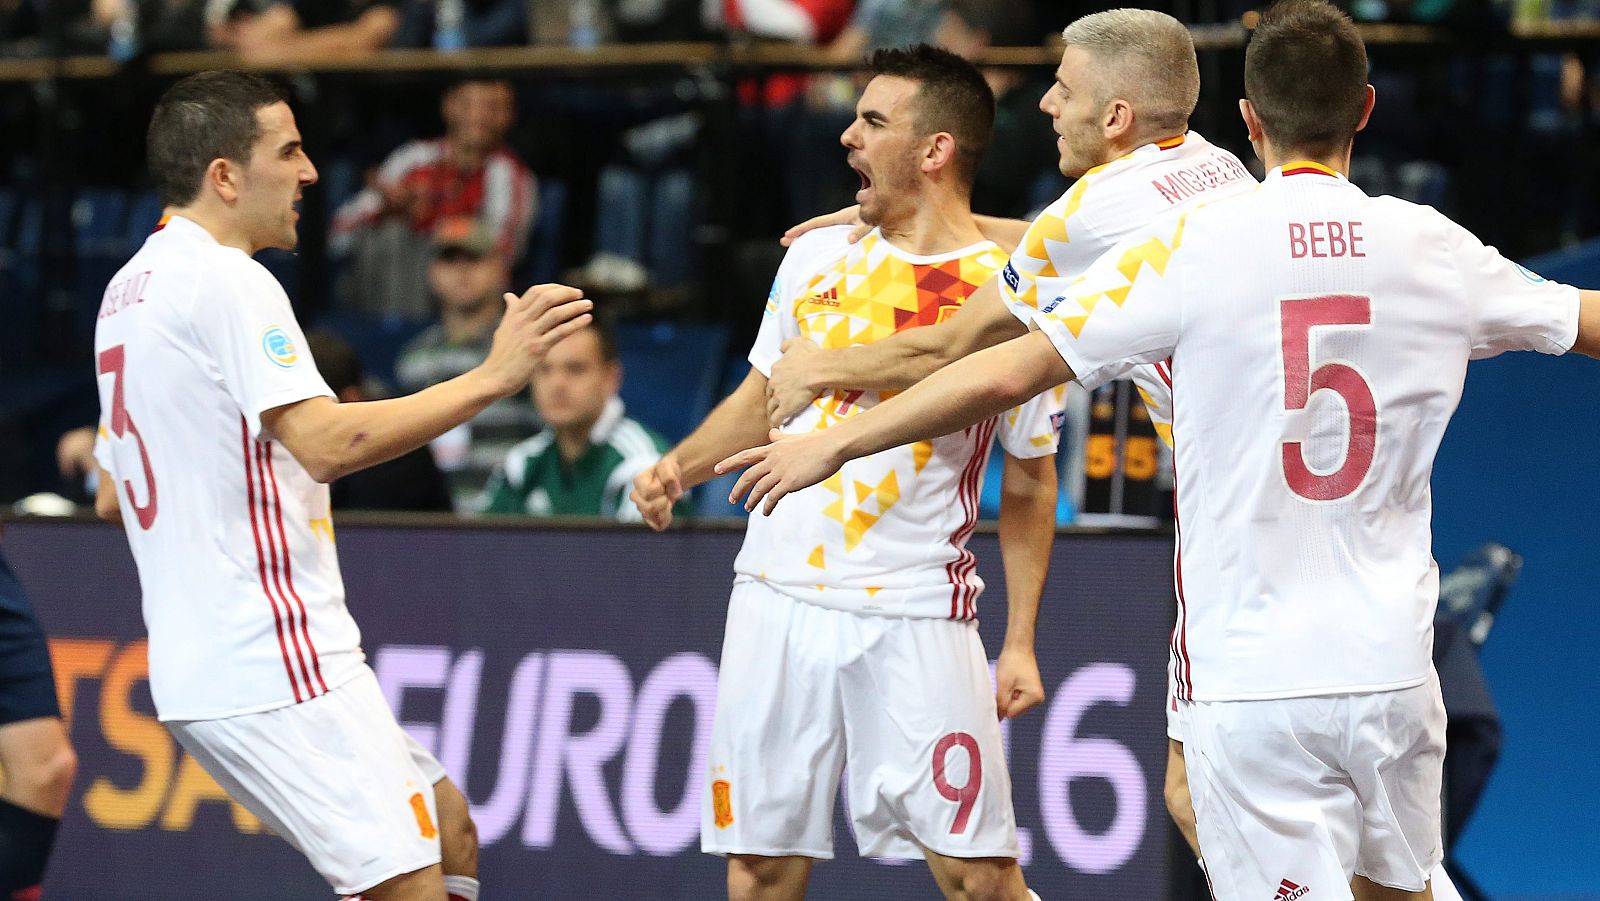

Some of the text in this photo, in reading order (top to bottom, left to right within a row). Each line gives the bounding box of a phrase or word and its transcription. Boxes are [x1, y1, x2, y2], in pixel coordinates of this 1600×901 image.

[1288, 220, 1367, 259] BEBE
[98, 343, 158, 531] 3
[1278, 293, 1379, 503] 5
[932, 731, 983, 835] 9
